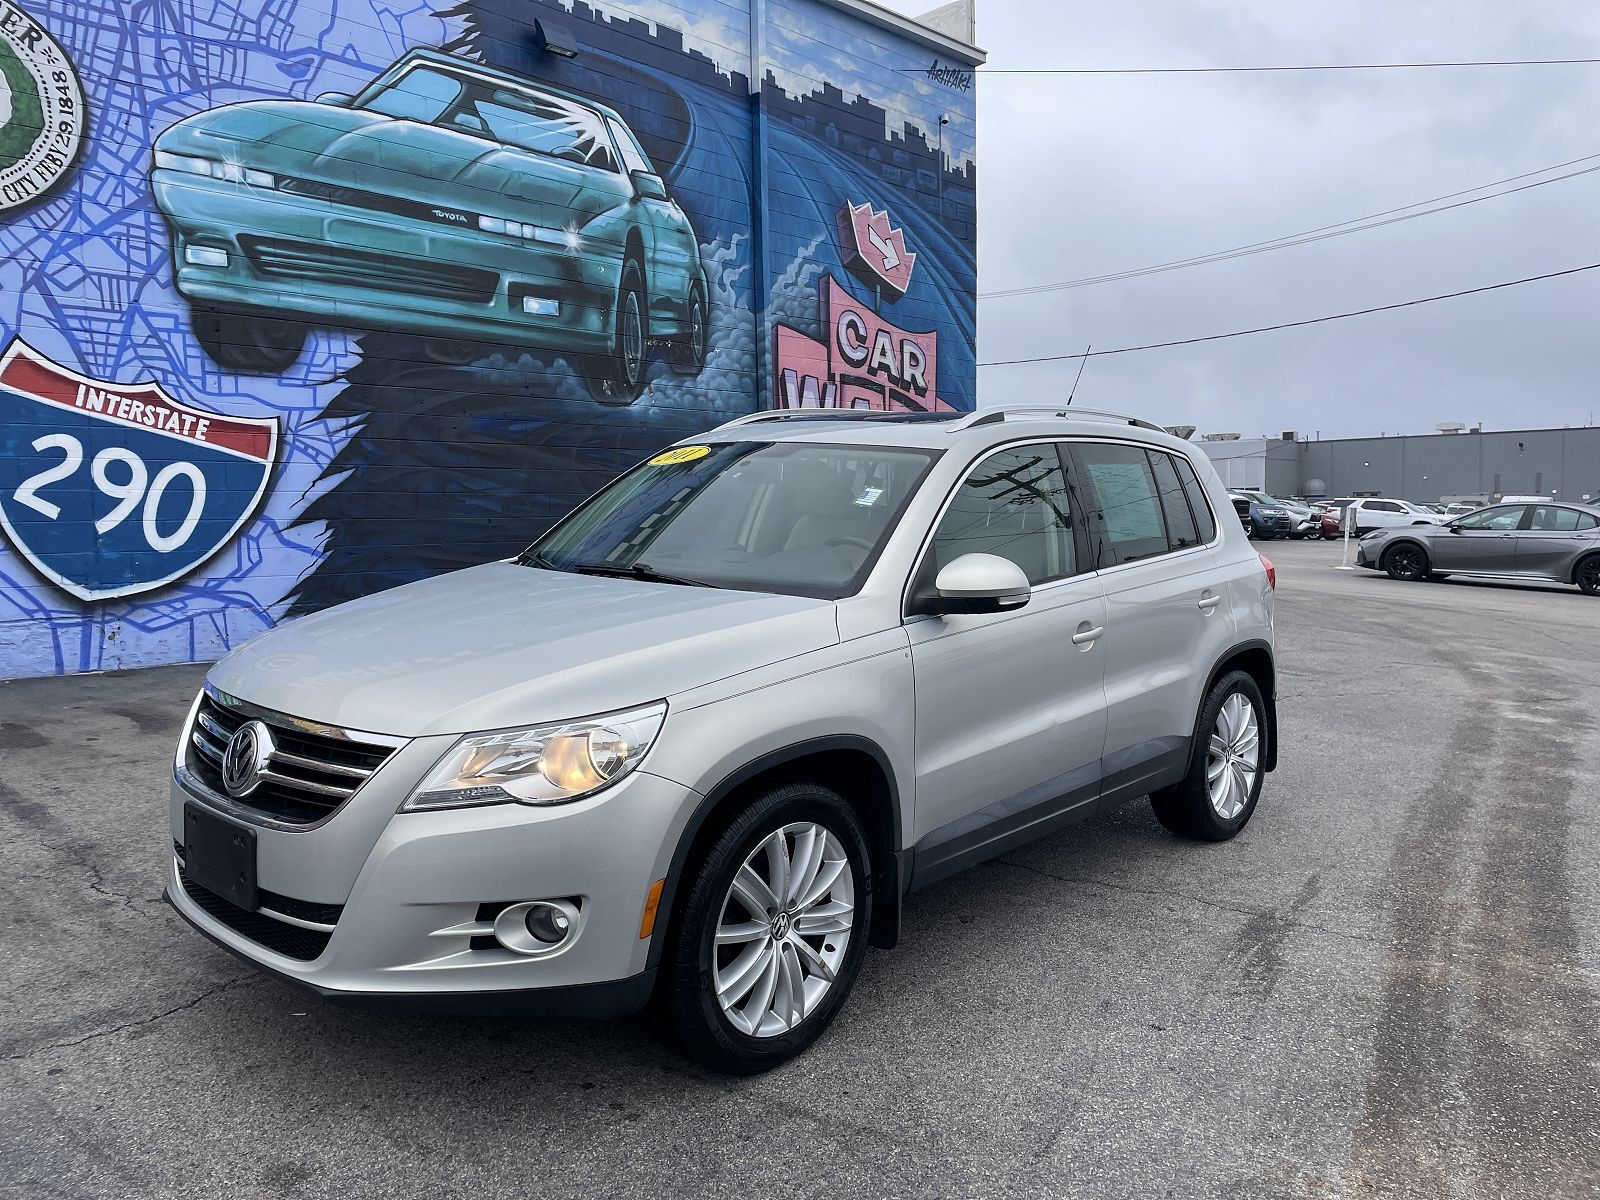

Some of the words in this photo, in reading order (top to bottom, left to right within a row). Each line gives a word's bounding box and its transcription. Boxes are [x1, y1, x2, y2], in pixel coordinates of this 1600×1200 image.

[0, 0, 43, 53] ER
[3, 173, 40, 202] CITY
[33, 143, 68, 183] FEBY
[432, 209, 468, 223] TOYOTA
[837, 310, 928, 398] CAR
[75, 383, 210, 441] INTERSTATE
[12, 433, 207, 553] 290
